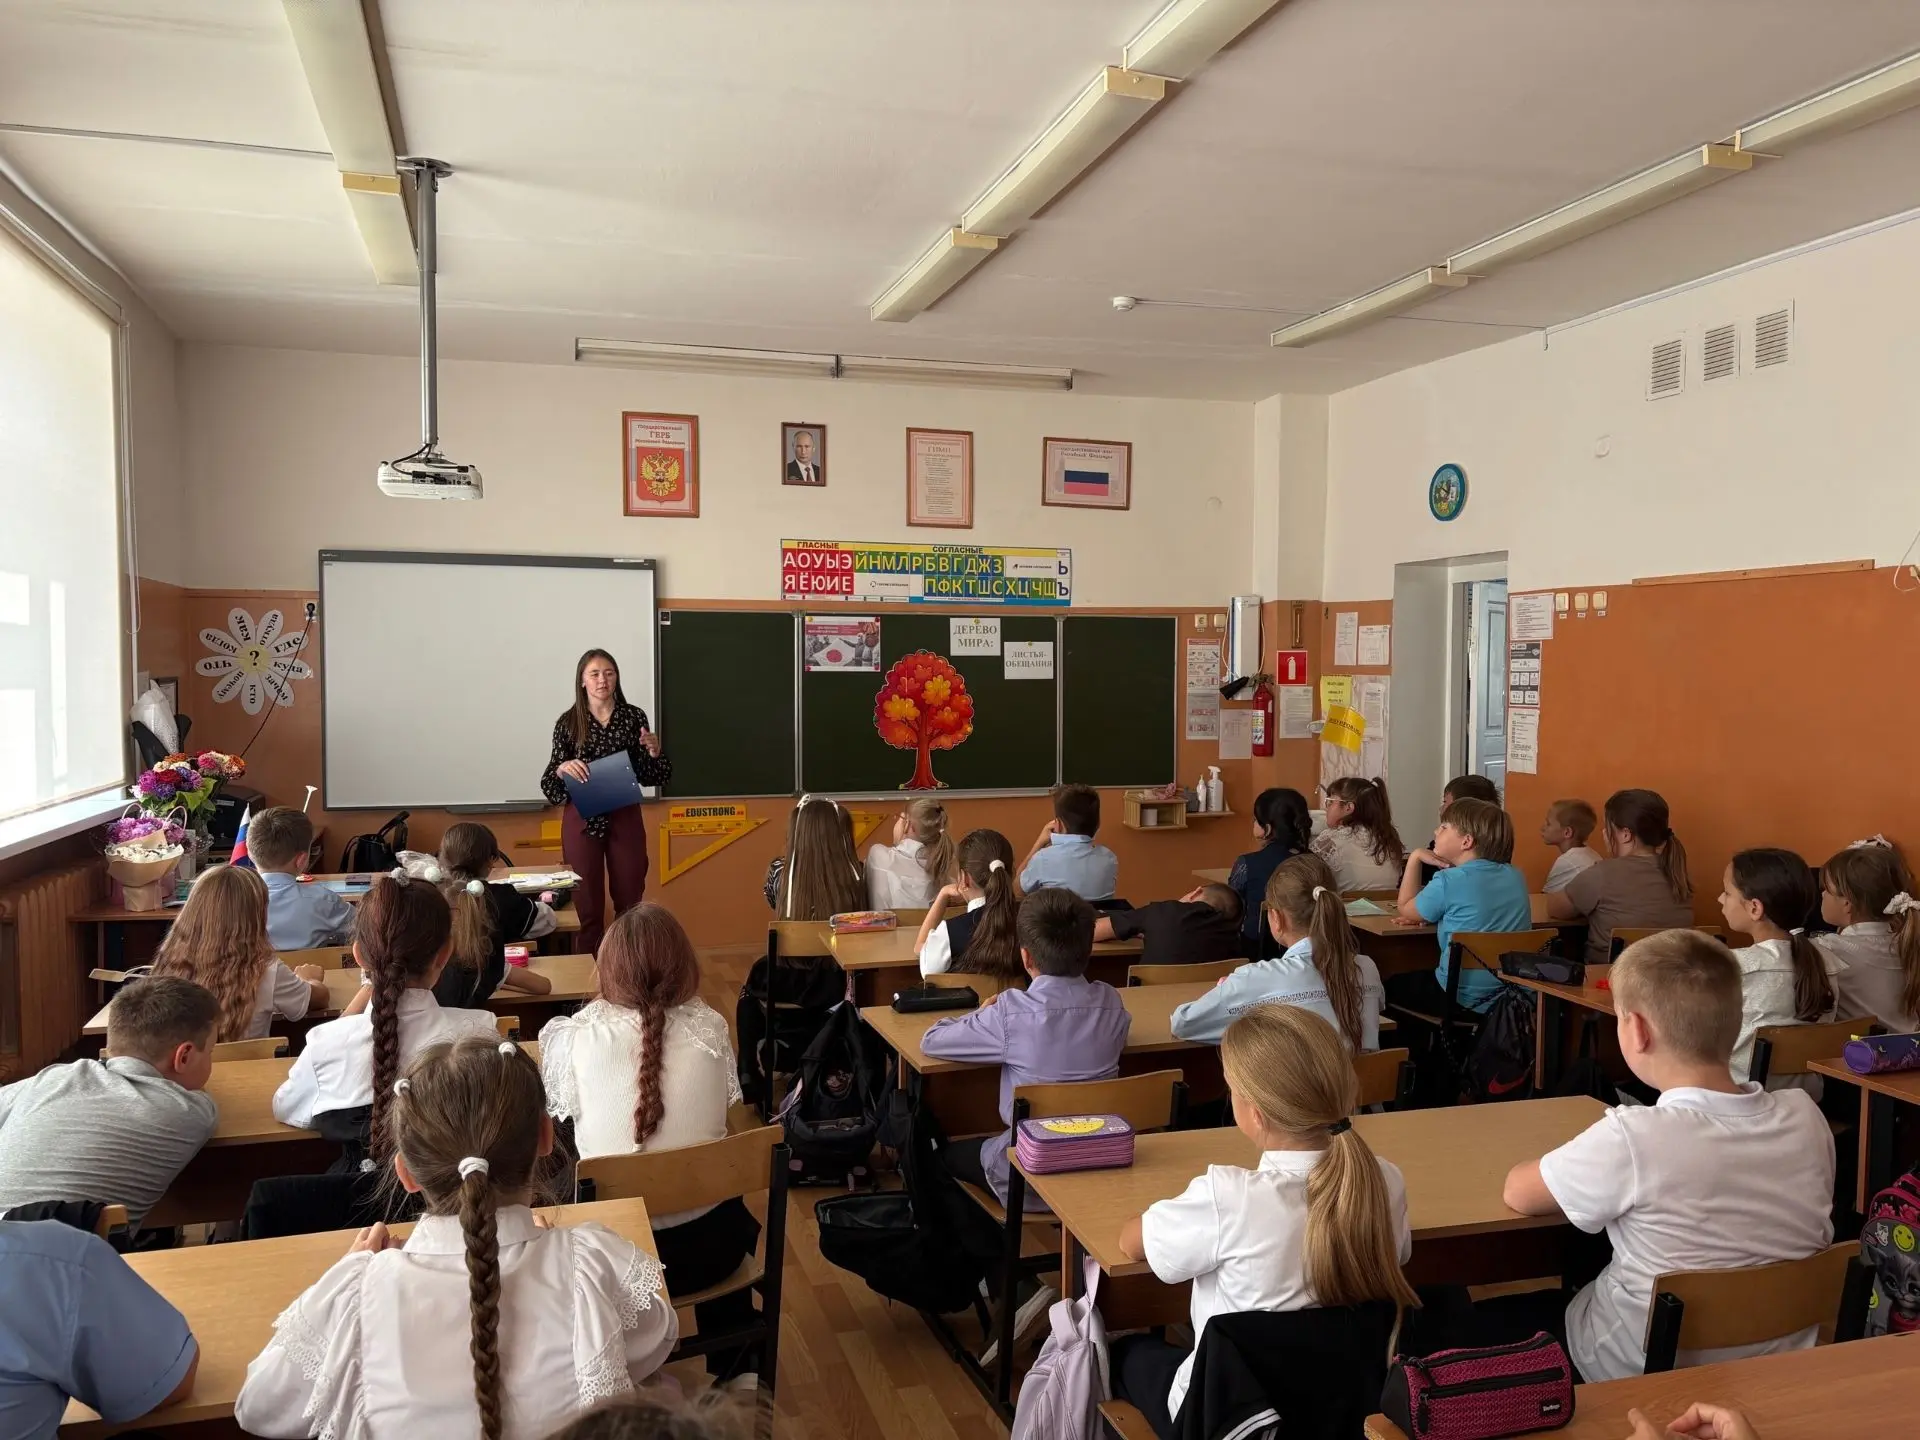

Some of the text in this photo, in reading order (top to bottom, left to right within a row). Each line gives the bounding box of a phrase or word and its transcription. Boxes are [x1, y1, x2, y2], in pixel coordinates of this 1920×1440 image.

[649, 431, 671, 439] ГЕРБ
[797, 541, 984, 554] ГЛАСНЫЕ СОГЛАСНЫЕ
[235, 615, 251, 641] как
[260, 614, 279, 645] откуда
[953, 625, 997, 635] ДЕРЕВО
[205, 633, 238, 653] когда
[274, 637, 301, 653] где
[958, 639, 994, 648] МИРА:
[204, 660, 232, 670] что
[250, 651, 259, 666] ?
[274, 661, 302, 673] куда
[217, 671, 244, 699] почему
[685, 806, 736, 818] EDUSTRONG
